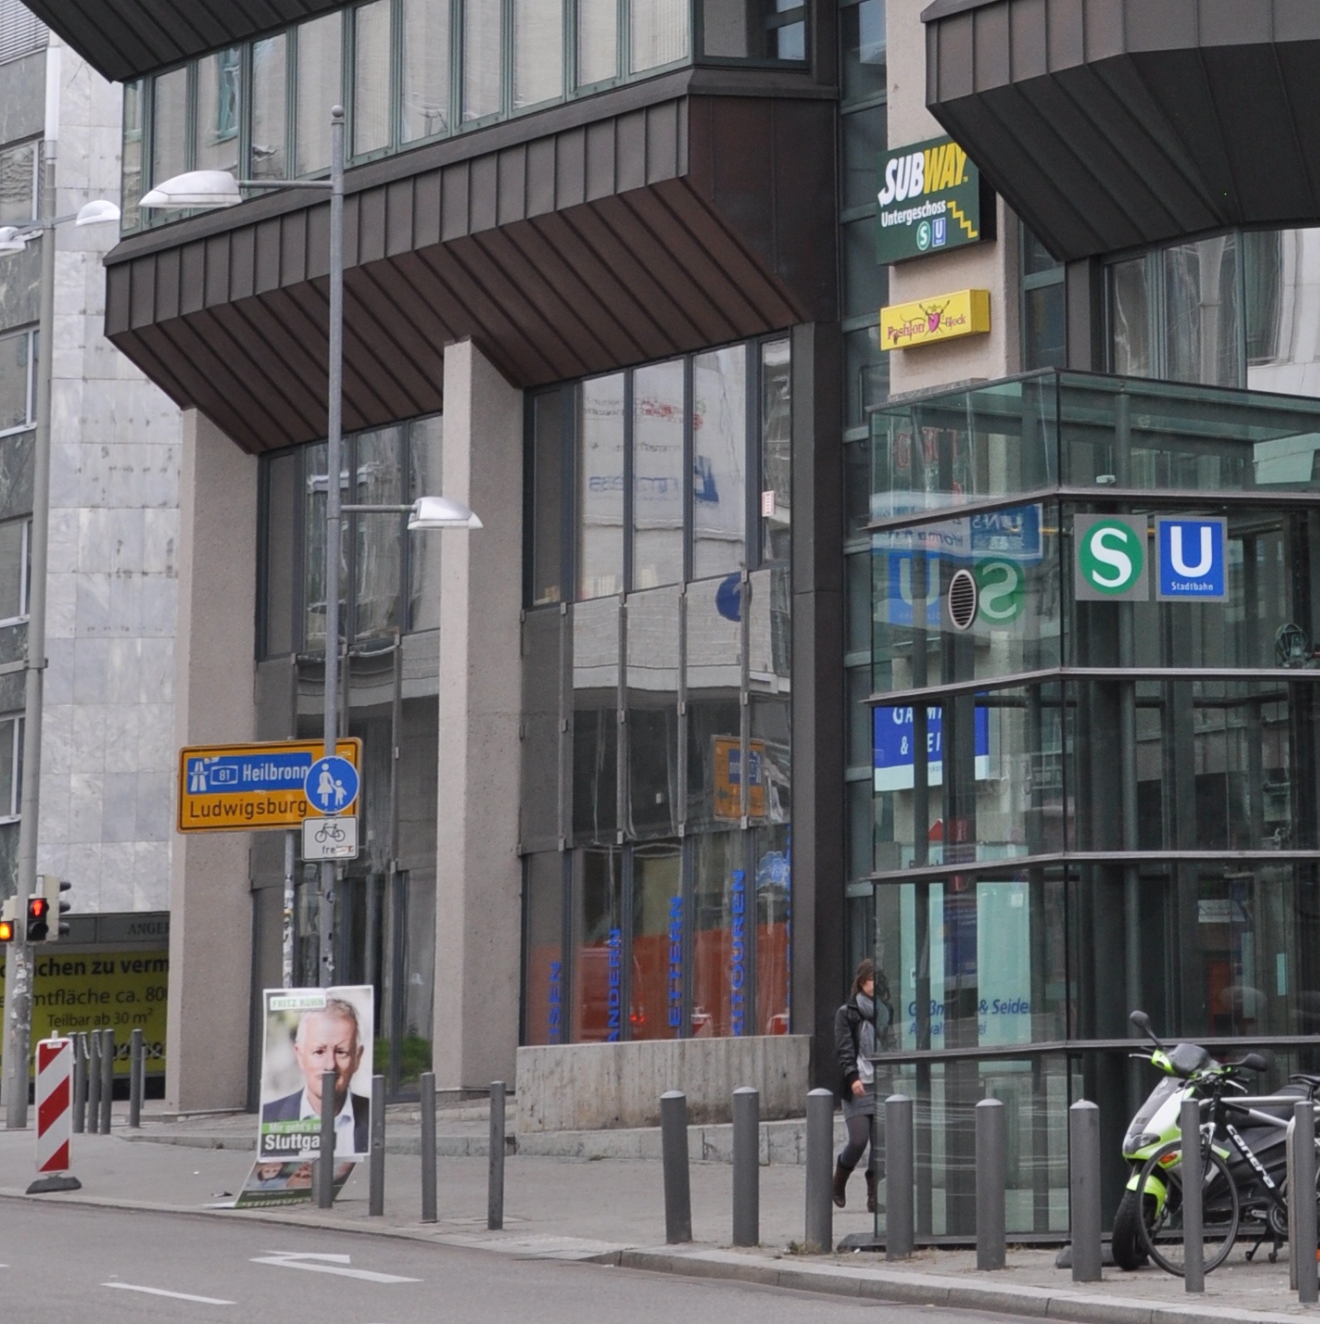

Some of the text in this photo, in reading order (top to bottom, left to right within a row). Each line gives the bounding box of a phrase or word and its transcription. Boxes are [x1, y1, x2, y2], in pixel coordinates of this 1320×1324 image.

[878, 142, 967, 207] SUBWAY
[881, 199, 946, 227] Untergeschoss
[1090, 526, 1213, 588] S U
[1171, 581, 1214, 591] Stadtbahn
[219, 763, 309, 782] 81 Heilbronn
[190, 797, 307, 820] Ludwigsburg
[668, 896, 683, 1028] ETTERN
[731, 869, 746, 1037] KITOUREN
[91, 960, 114, 975] zu
[116, 990, 140, 1004] ca.
[607, 928, 622, 1043] ANDERN
[992, 997, 1030, 1015] Seide
[48, 1013, 90, 1027] Teilbar
[95, 1012, 110, 1026] ab
[114, 1012, 129, 1025] 30
